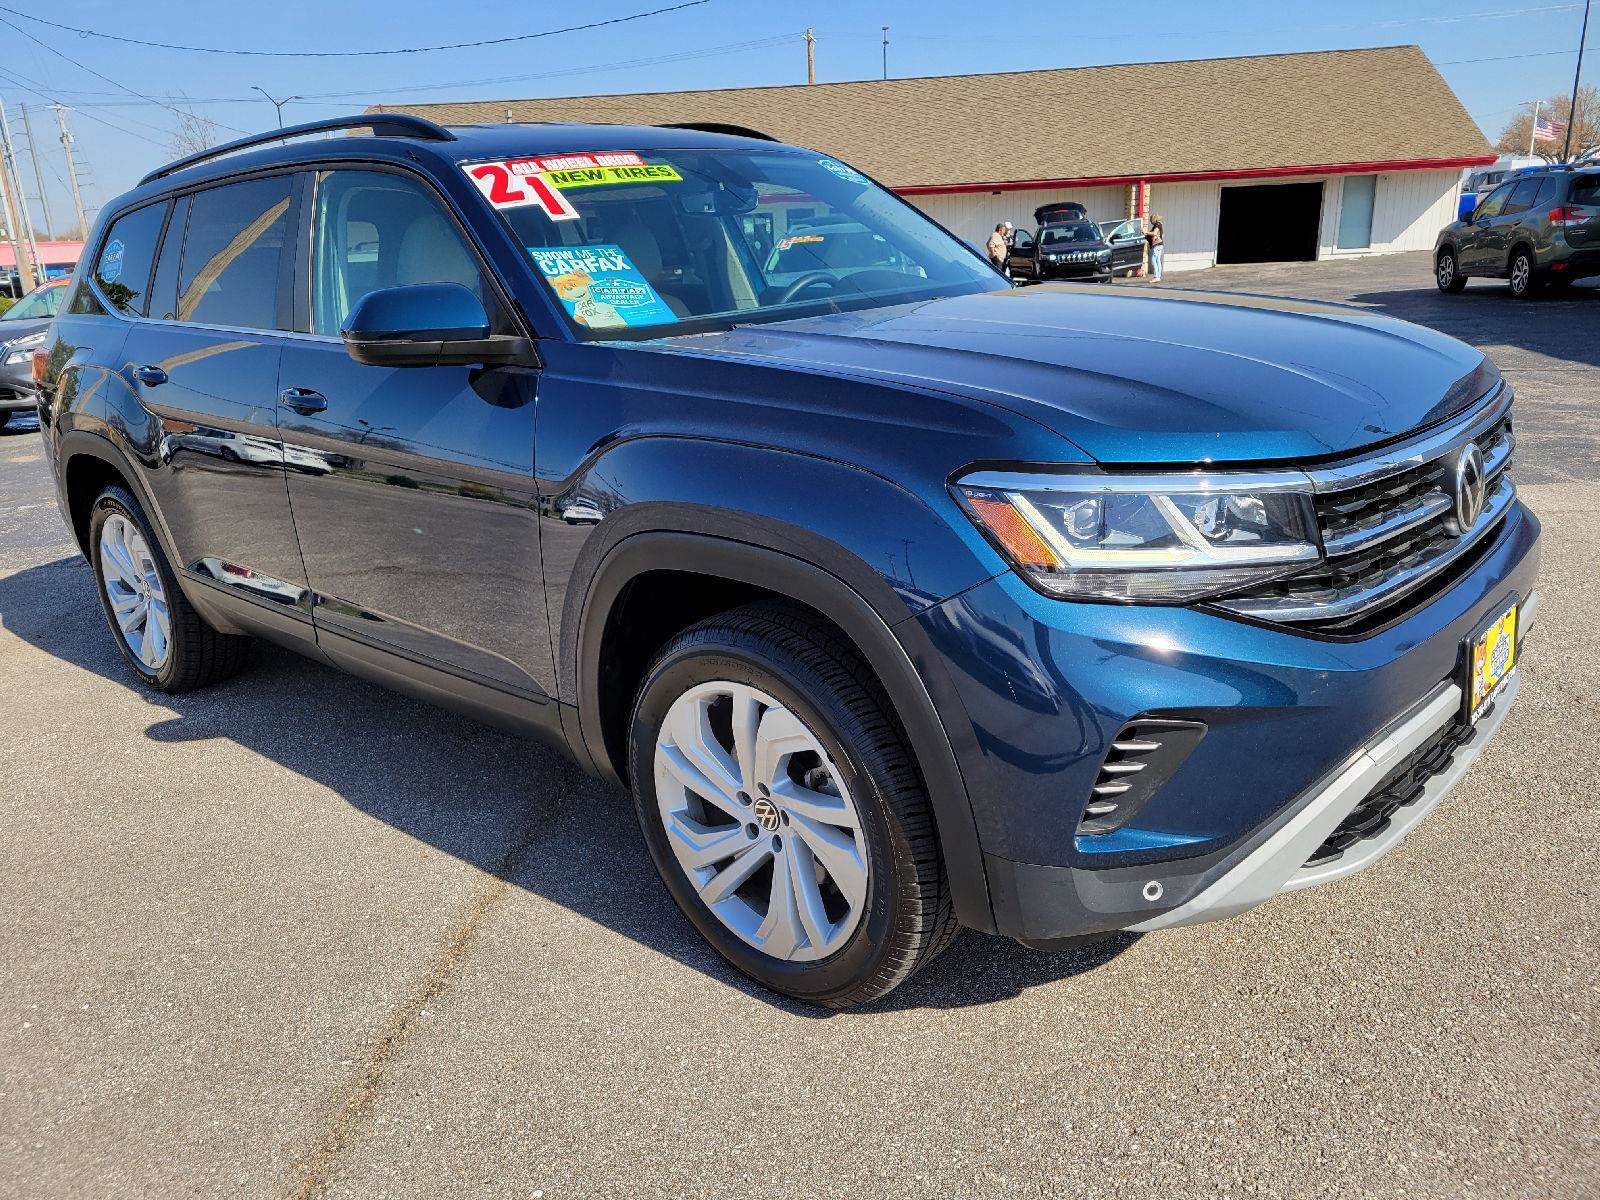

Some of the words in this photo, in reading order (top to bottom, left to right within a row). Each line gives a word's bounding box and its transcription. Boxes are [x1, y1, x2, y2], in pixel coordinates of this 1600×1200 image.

[511, 161, 541, 175] ALL
[542, 157, 598, 171] WHEEL
[594, 154, 643, 167] DRIVE
[550, 169, 603, 184] NEW
[607, 165, 675, 179] TIRES
[471, 165, 566, 215] 21
[532, 250, 575, 261] SHOW
[574, 248, 595, 259] ME
[595, 247, 621, 258] THE
[539, 255, 632, 275] CARFAX
